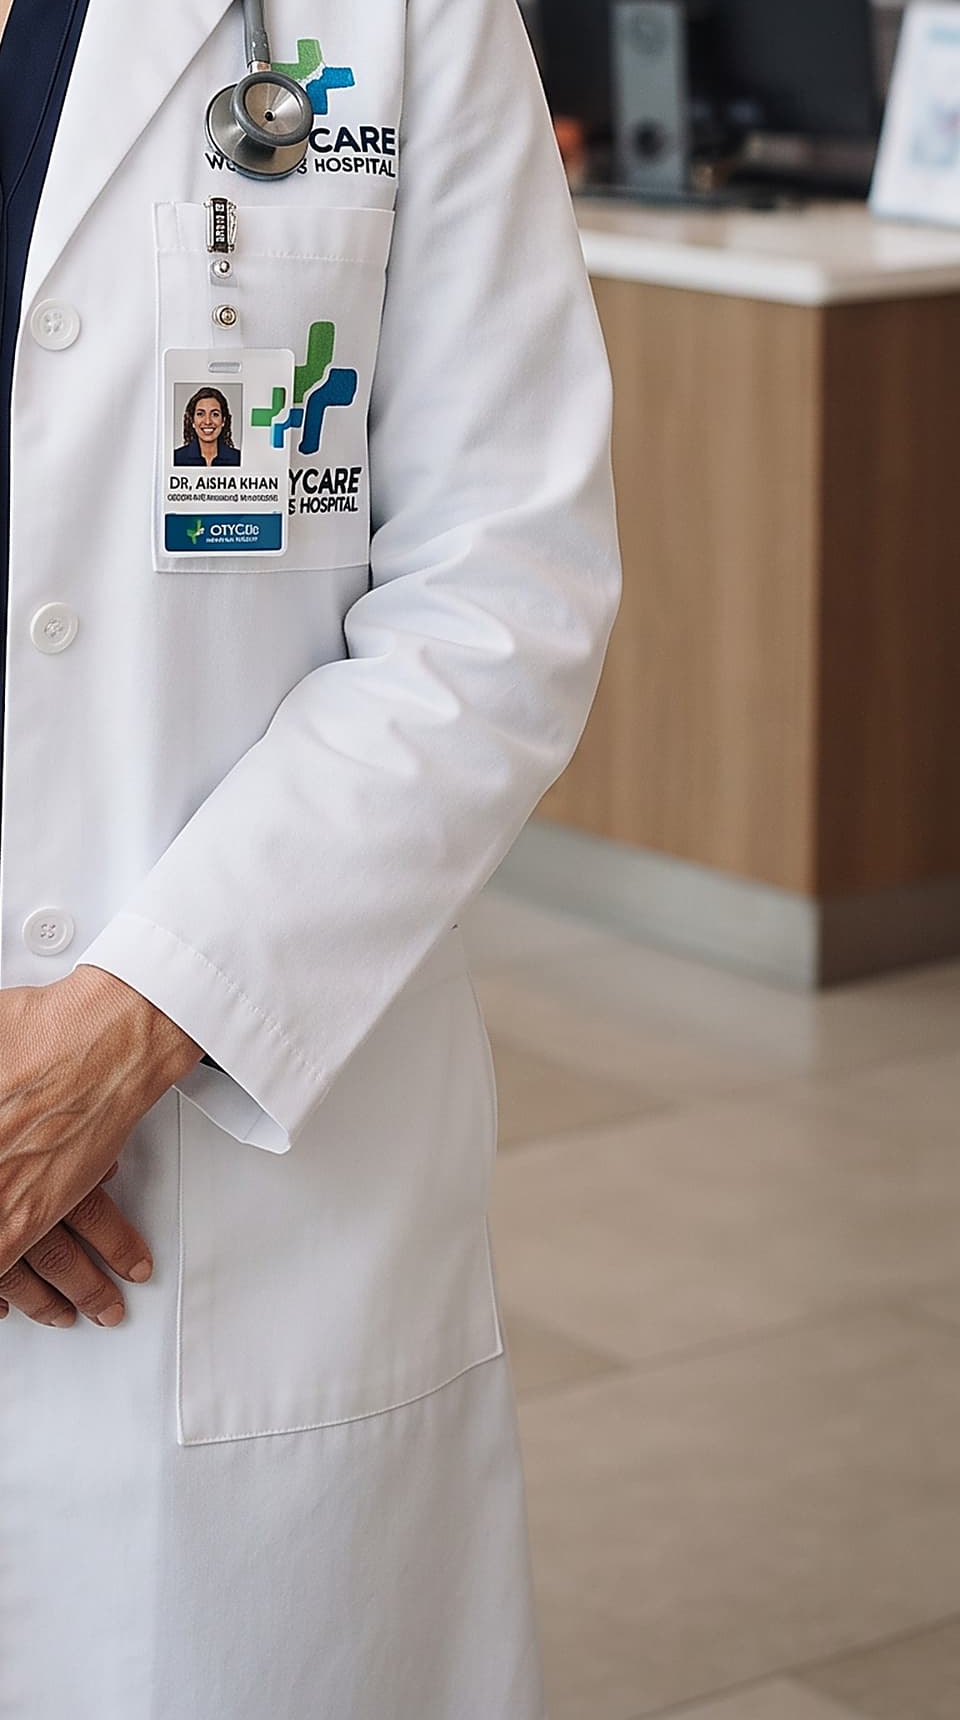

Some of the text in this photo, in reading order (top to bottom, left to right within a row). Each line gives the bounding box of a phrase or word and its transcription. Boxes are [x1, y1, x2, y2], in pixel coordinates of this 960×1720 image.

[308, 126, 396, 156] CARE
[314, 157, 396, 178] HOSPITAL
[196, 476, 237, 490] AISHA
[239, 476, 279, 490] KHAN
[288, 466, 362, 495] YCARE
[300, 496, 358, 514] HOSPITAL
